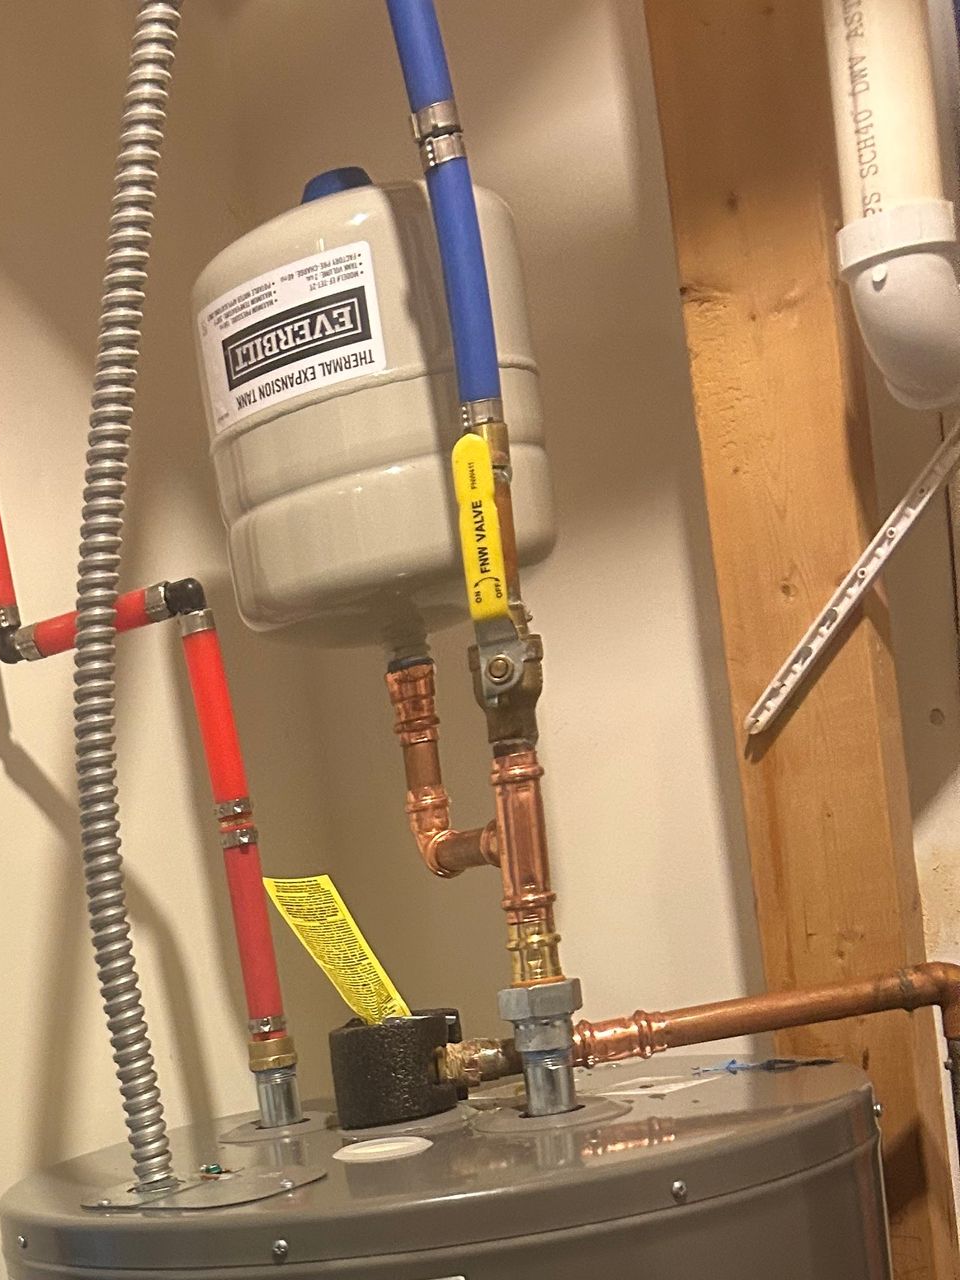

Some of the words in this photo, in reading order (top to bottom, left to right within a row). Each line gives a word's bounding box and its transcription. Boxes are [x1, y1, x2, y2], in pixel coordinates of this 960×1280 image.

[848, 55, 870, 97] DWV
[852, 108, 879, 180] SCH40
[236, 307, 352, 369] EVERBILT
[318, 349, 374, 375] THERMAL
[258, 366, 316, 399] EXPANSION
[235, 389, 257, 410] TANK
[471, 500, 486, 542] VALVE
[477, 546, 490, 574] FNW
[474, 590, 482, 603] ON
[494, 582, 503, 598] OFF
